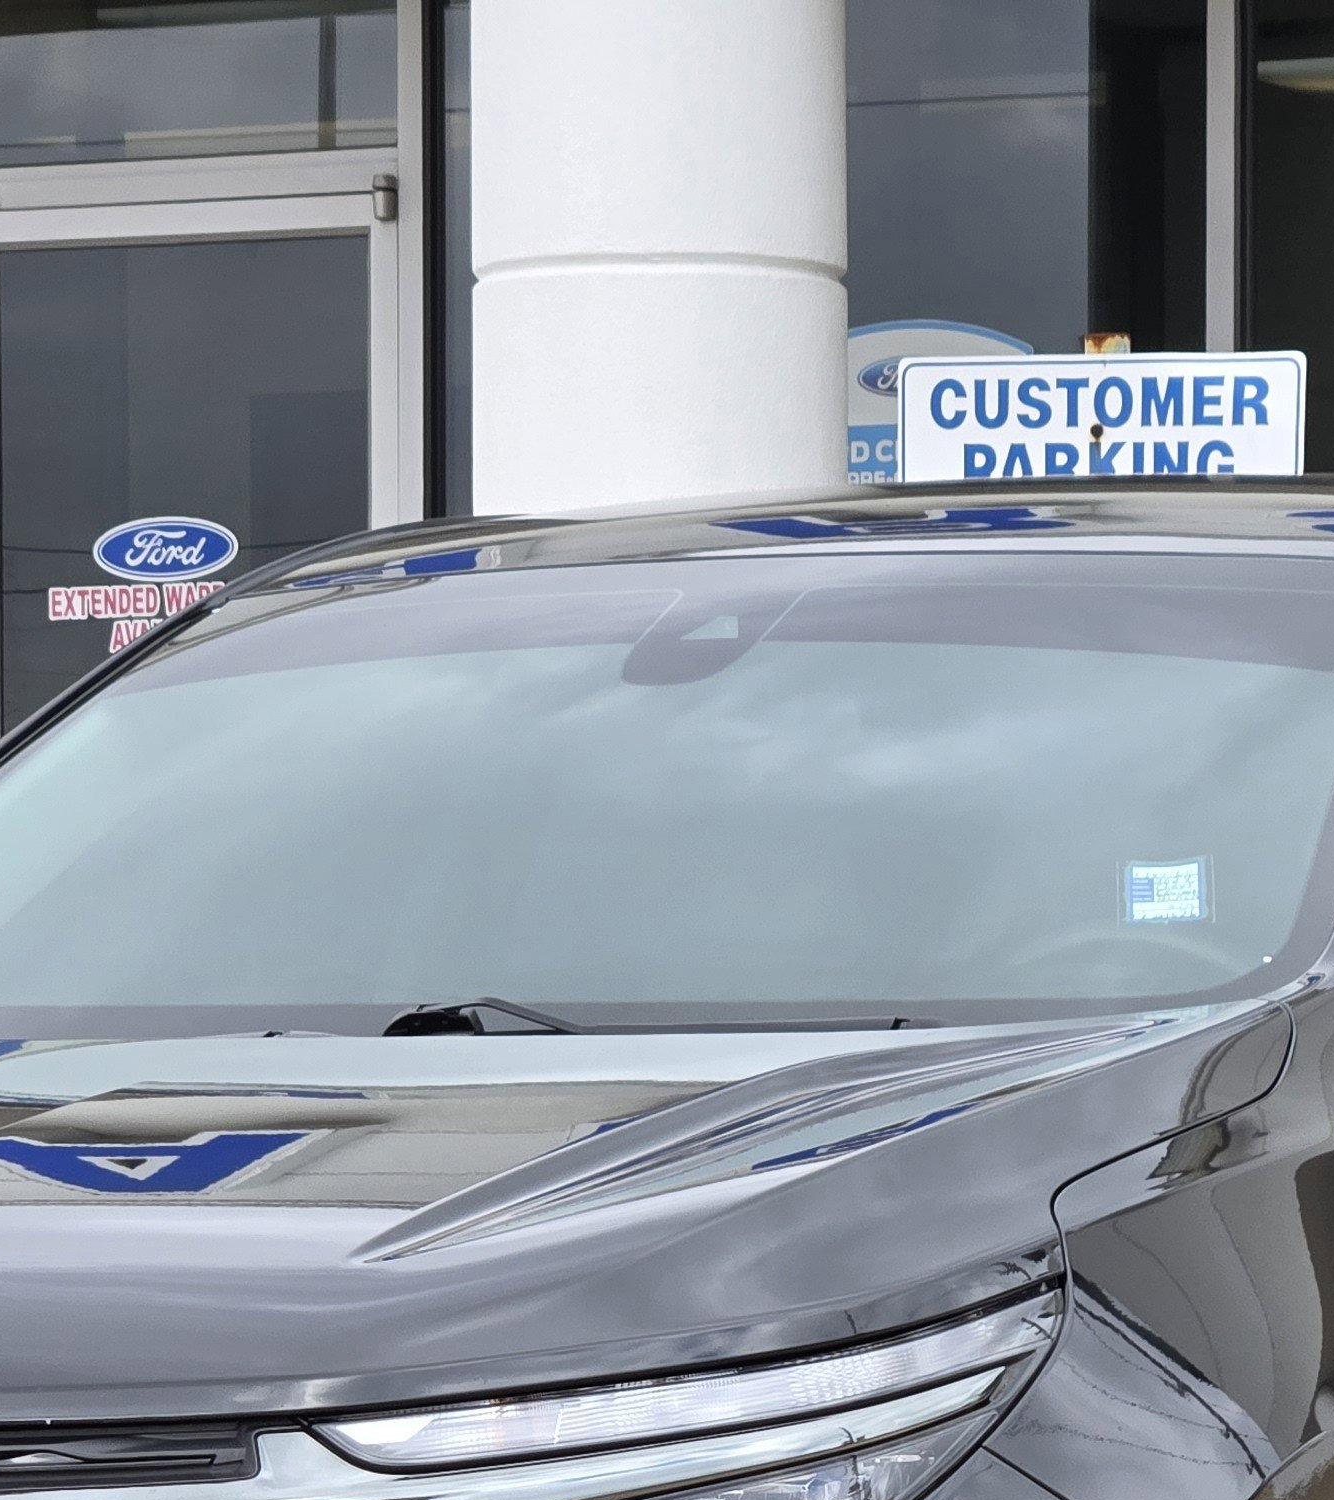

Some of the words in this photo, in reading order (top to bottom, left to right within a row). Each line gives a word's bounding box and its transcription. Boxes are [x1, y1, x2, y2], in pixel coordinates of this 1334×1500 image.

[929, 375, 1270, 430] CUSTOMER
[963, 439, 1236, 479] PARKING
[124, 529, 207, 567] Ford
[49, 584, 161, 621] EXTENDED
